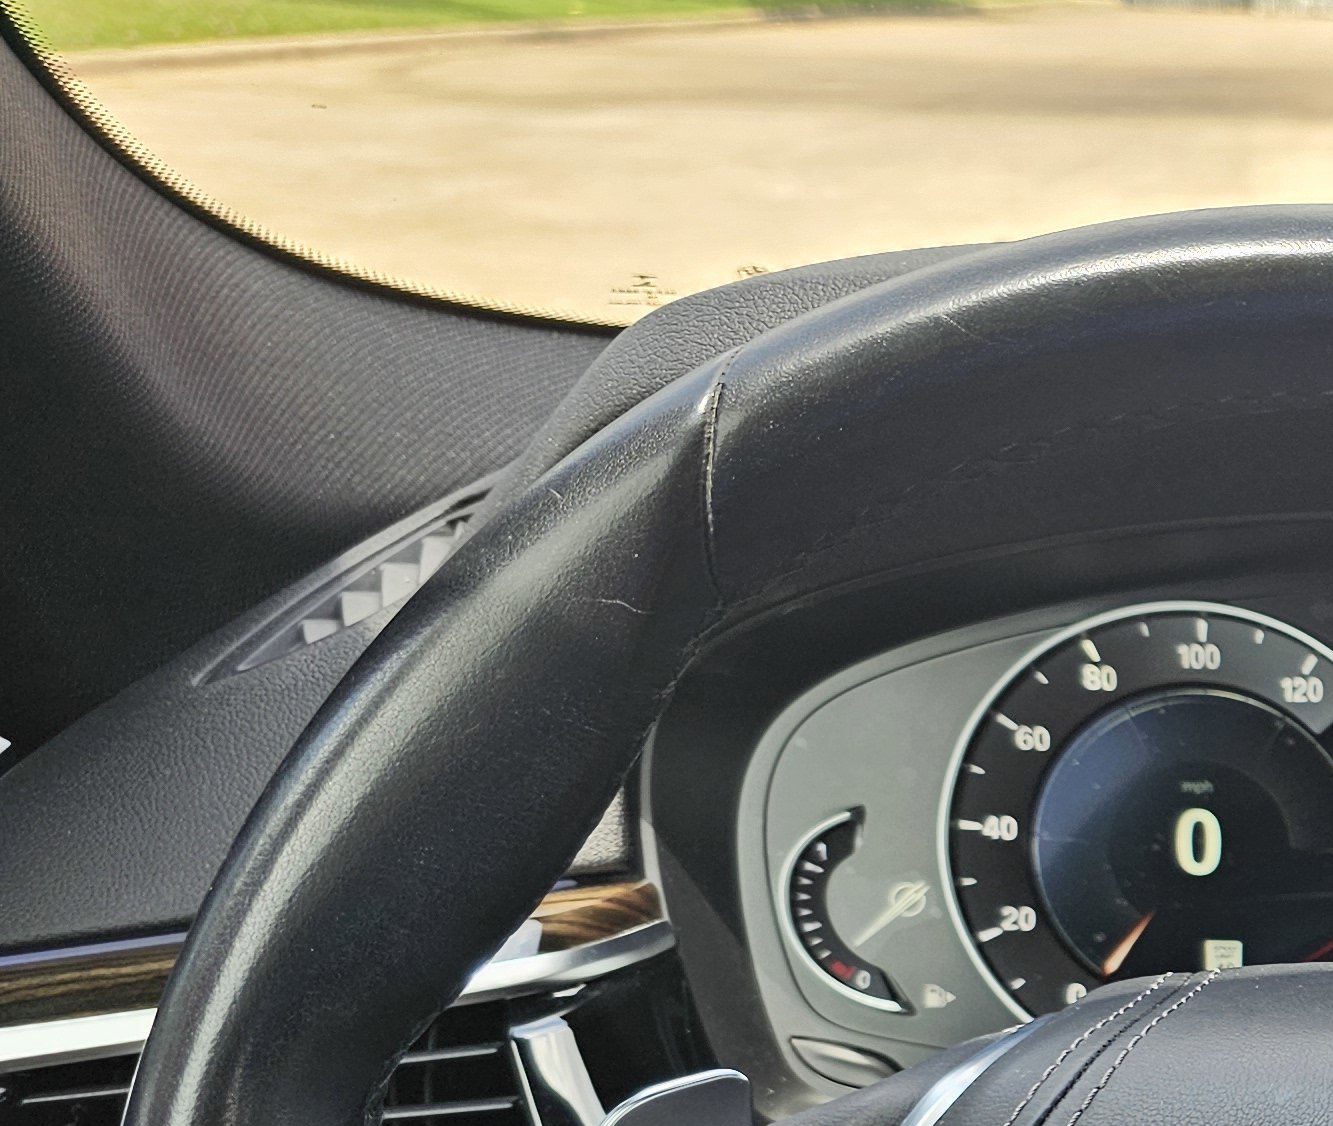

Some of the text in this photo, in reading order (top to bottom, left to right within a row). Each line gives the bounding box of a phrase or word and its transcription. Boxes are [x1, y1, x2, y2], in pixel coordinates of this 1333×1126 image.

[1177, 643, 1222, 671] 100
[1080, 663, 1118, 693] 80
[1279, 676, 1324, 703] 120
[1014, 725, 1051, 752] 60
[980, 814, 1018, 841] 40
[1174, 807, 1223, 877] 0
[1000, 905, 1037, 932] 20
